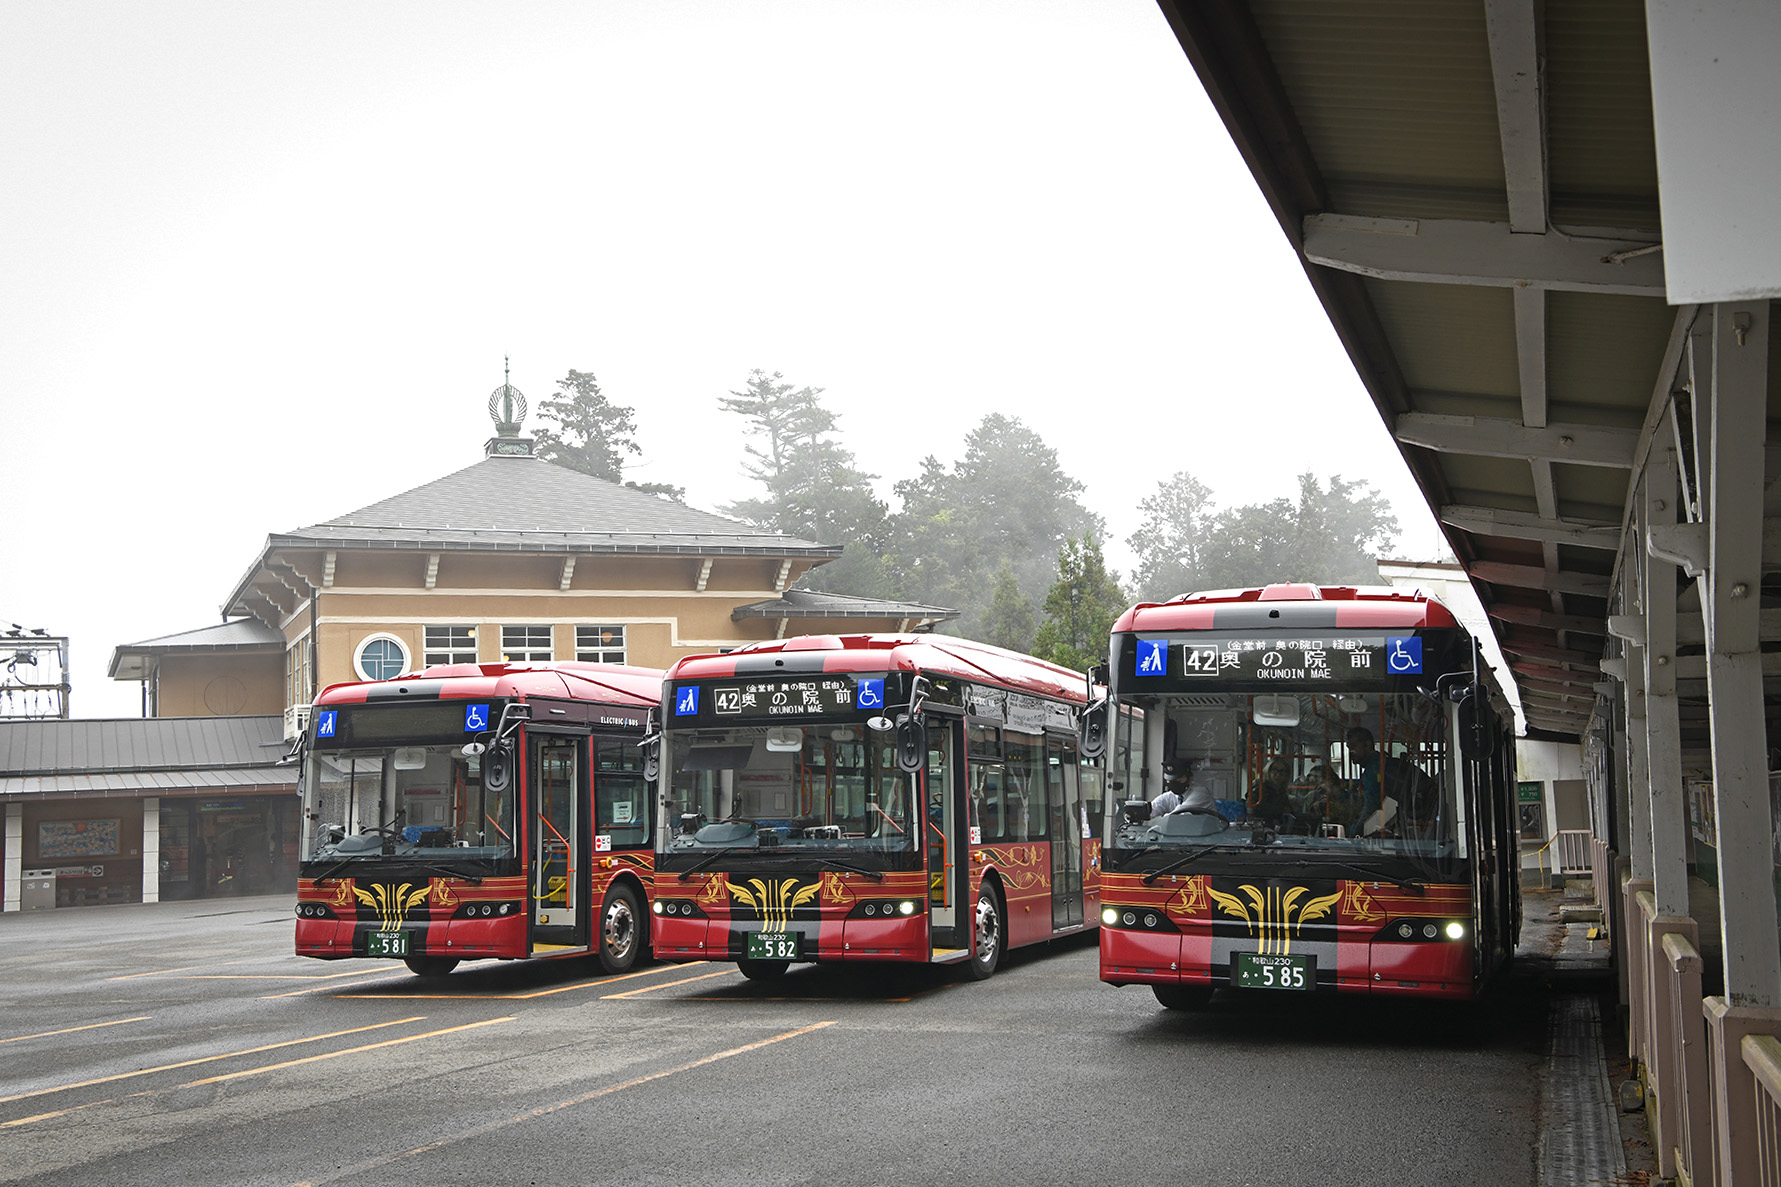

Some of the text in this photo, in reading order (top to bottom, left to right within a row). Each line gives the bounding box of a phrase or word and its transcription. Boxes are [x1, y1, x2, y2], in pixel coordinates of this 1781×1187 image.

[1187, 650, 1217, 671] 42
[1256, 668, 1332, 679] OKUNOIN MAE
[717, 692, 740, 710] 42
[768, 703, 824, 715] OKUNOIN MAE
[600, 716, 639, 727] ELECTRIC BUS
